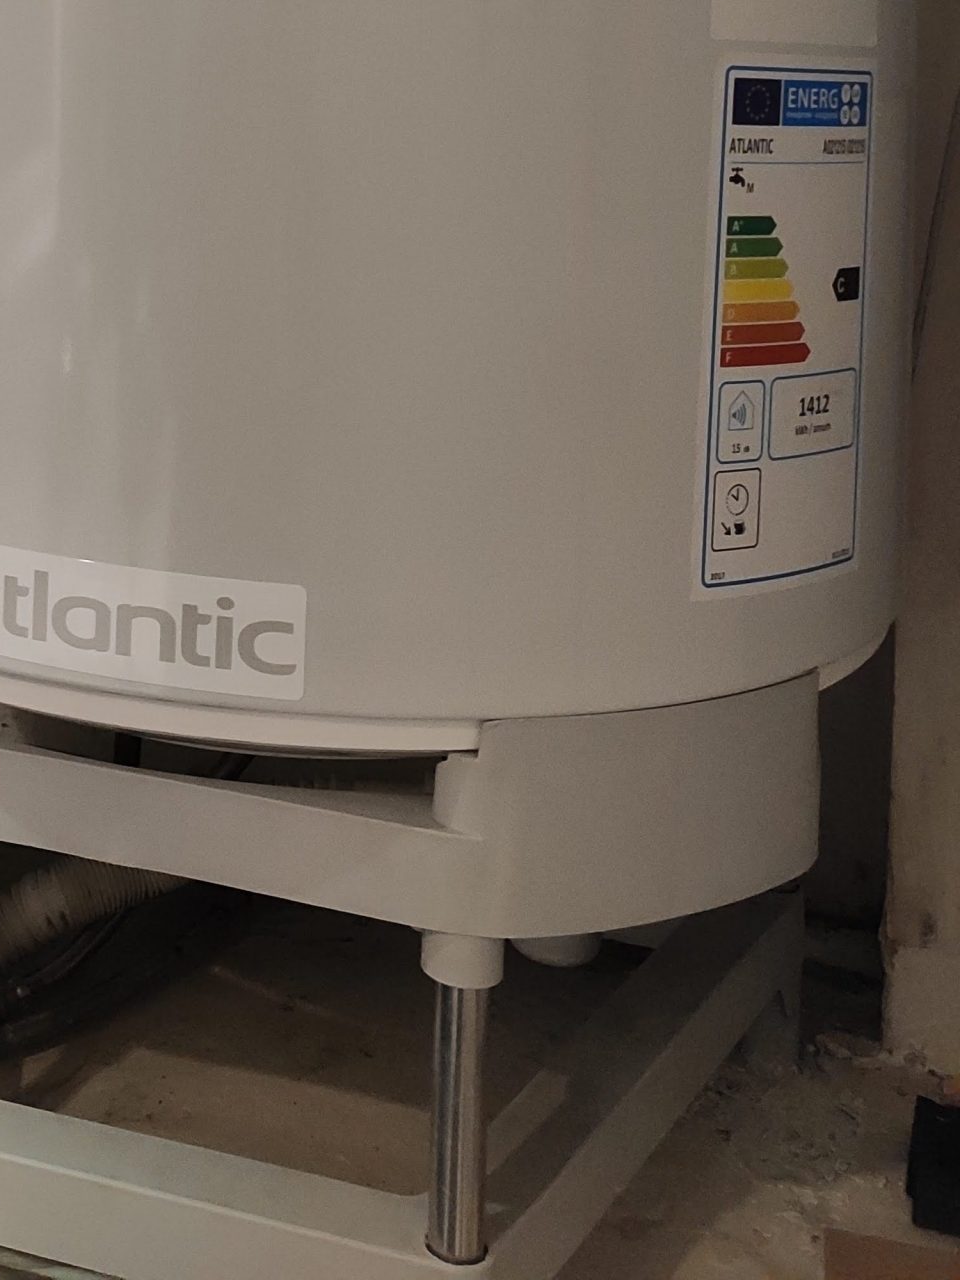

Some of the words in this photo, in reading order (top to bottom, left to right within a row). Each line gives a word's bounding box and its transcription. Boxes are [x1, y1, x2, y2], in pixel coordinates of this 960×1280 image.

[787, 87, 839, 109] ENERG
[729, 138, 775, 154] ATLANTIC
[837, 277, 845, 293] C
[799, 394, 830, 417] 1412
[732, 443, 741, 454] 15
